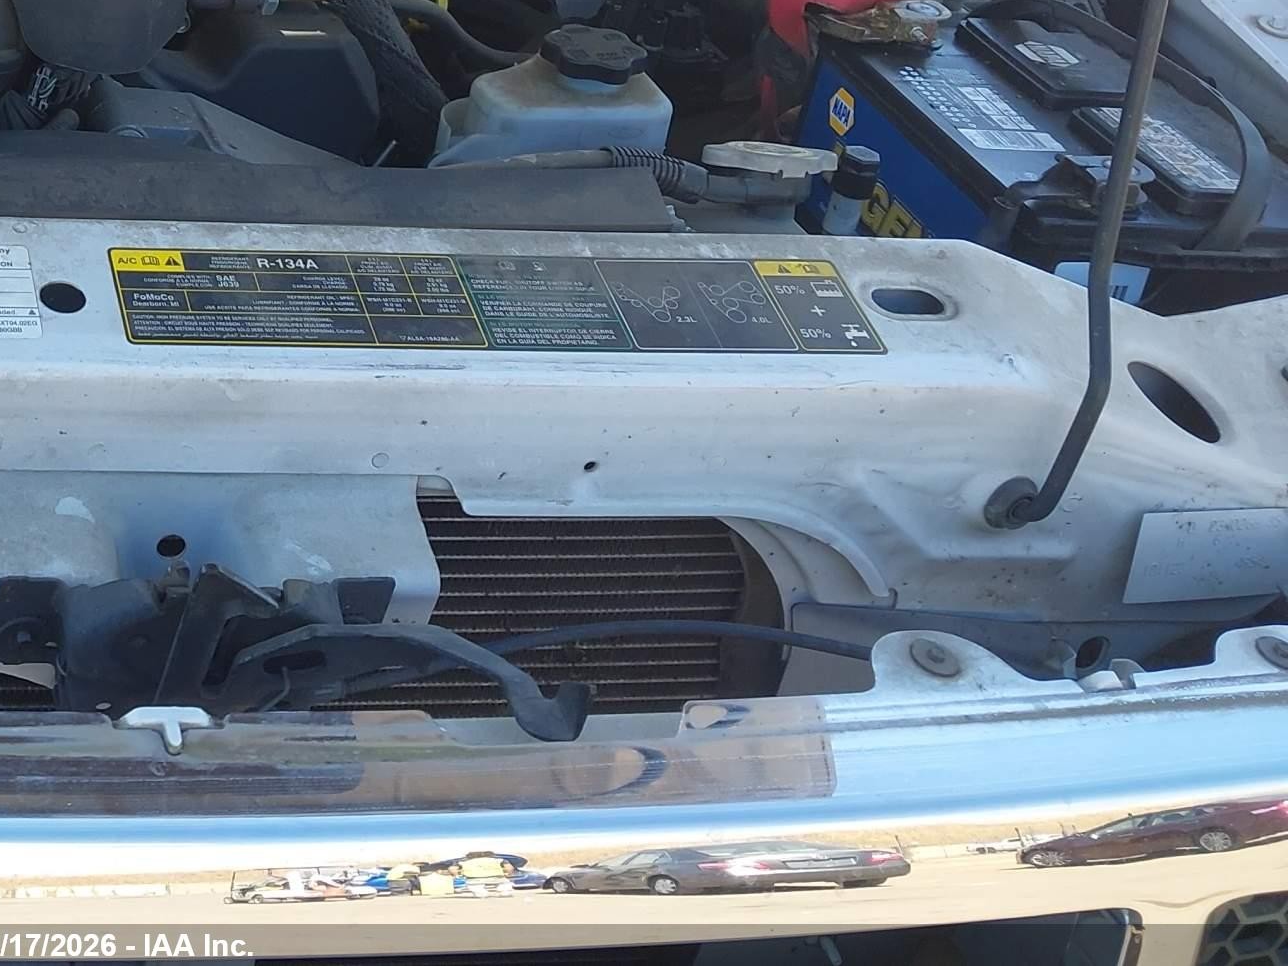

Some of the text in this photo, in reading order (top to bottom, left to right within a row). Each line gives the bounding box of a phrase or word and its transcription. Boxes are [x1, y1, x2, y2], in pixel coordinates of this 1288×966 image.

[256, 257, 319, 269] R-134A
[774, 285, 806, 295] 50%
[133, 293, 174, 301] FoMoCo
[800, 328, 832, 339] 50%
